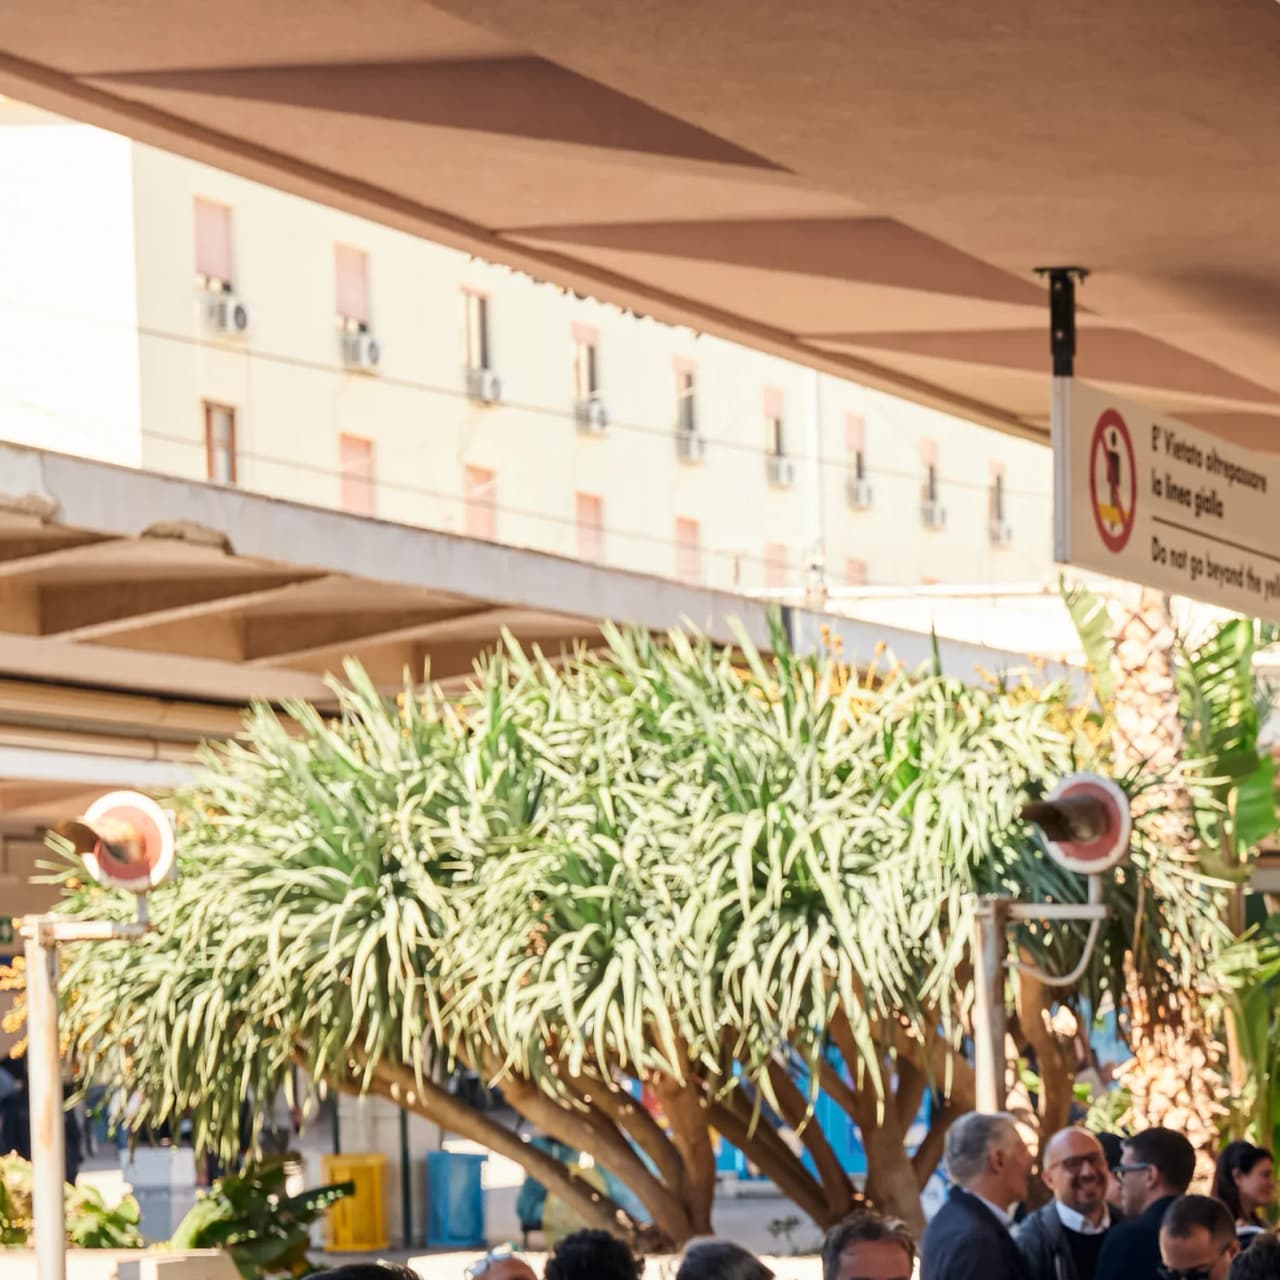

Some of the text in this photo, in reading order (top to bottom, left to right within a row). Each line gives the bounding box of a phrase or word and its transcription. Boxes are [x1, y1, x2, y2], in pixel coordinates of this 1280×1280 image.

[1164, 430, 1203, 468] Vietato
[1205, 447, 1267, 494] oltrepassare
[1152, 467, 1224, 519] la linea gialla
[1152, 536, 1167, 565] Do
[1170, 549, 1188, 570] not
[1190, 555, 1203, 582] go
[1206, 551, 1244, 589] beyond
[1246, 565, 1261, 593] the
